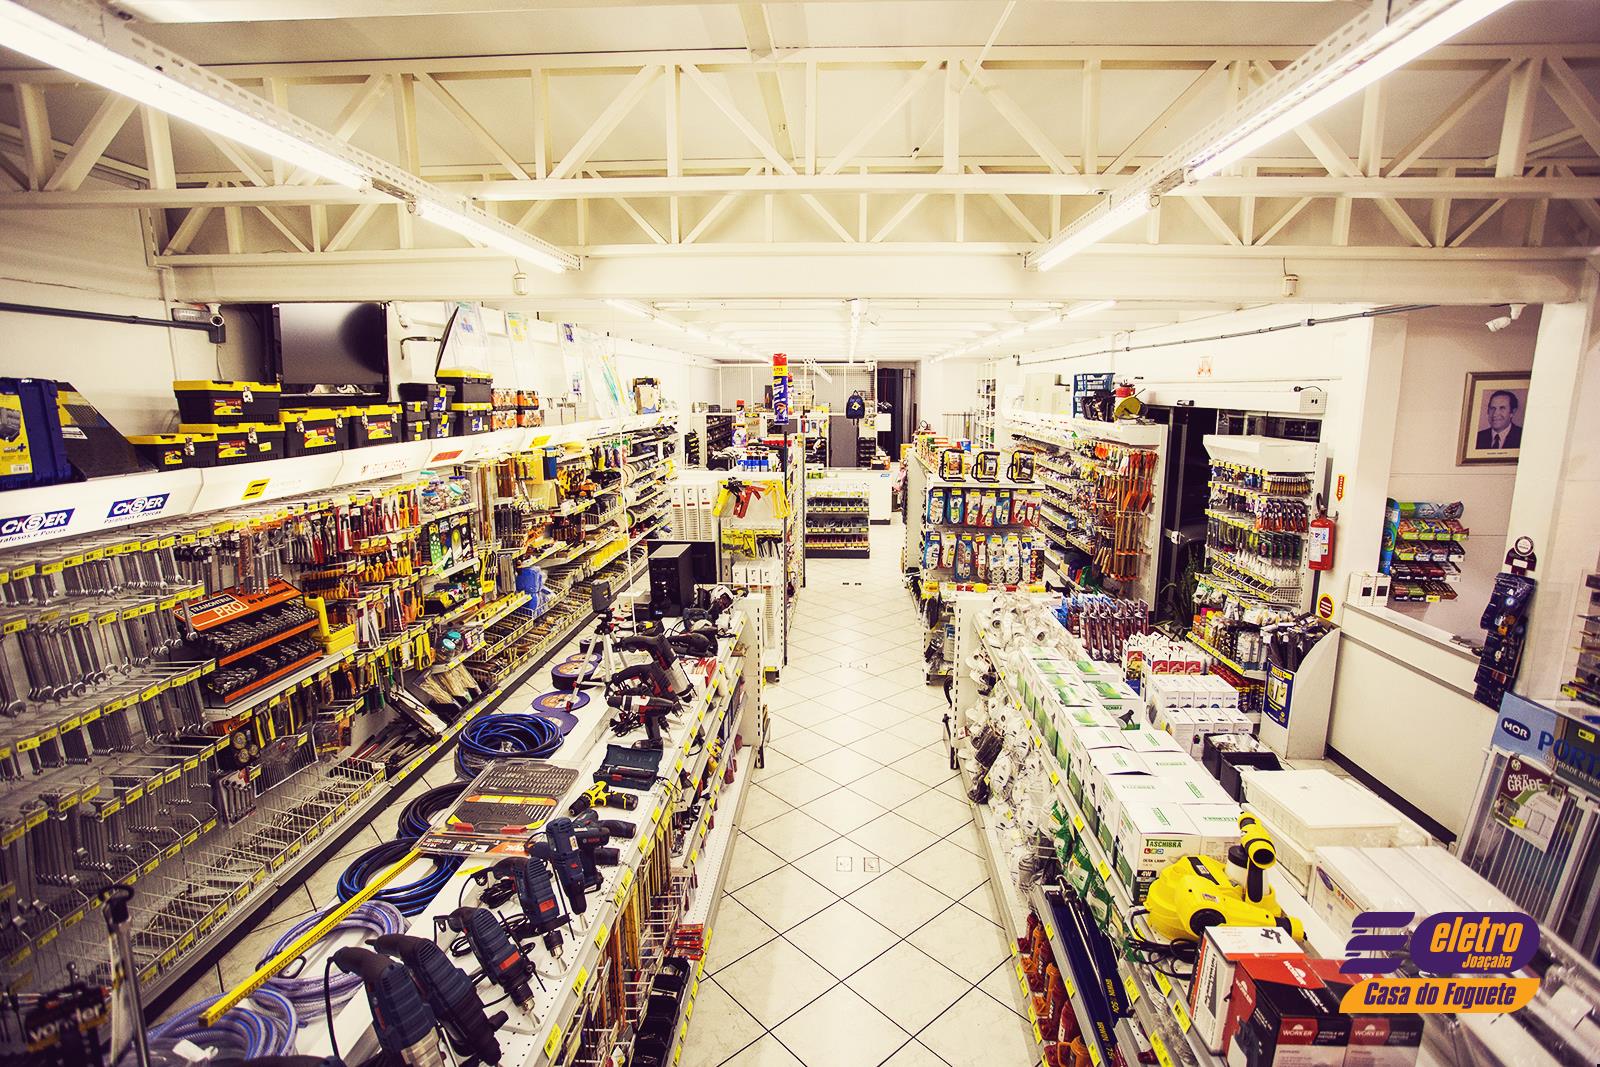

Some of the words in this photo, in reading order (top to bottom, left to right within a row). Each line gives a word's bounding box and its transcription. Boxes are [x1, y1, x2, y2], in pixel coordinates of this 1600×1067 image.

[214, 601, 245, 618] PRO
[1504, 720, 1528, 738] MOR
[1507, 778, 1545, 791] GRADE
[1145, 838, 1183, 849] TASCHIBRA
[1282, 1029, 1314, 1037] WORKER
[1354, 1029, 1386, 1037] WORKER
